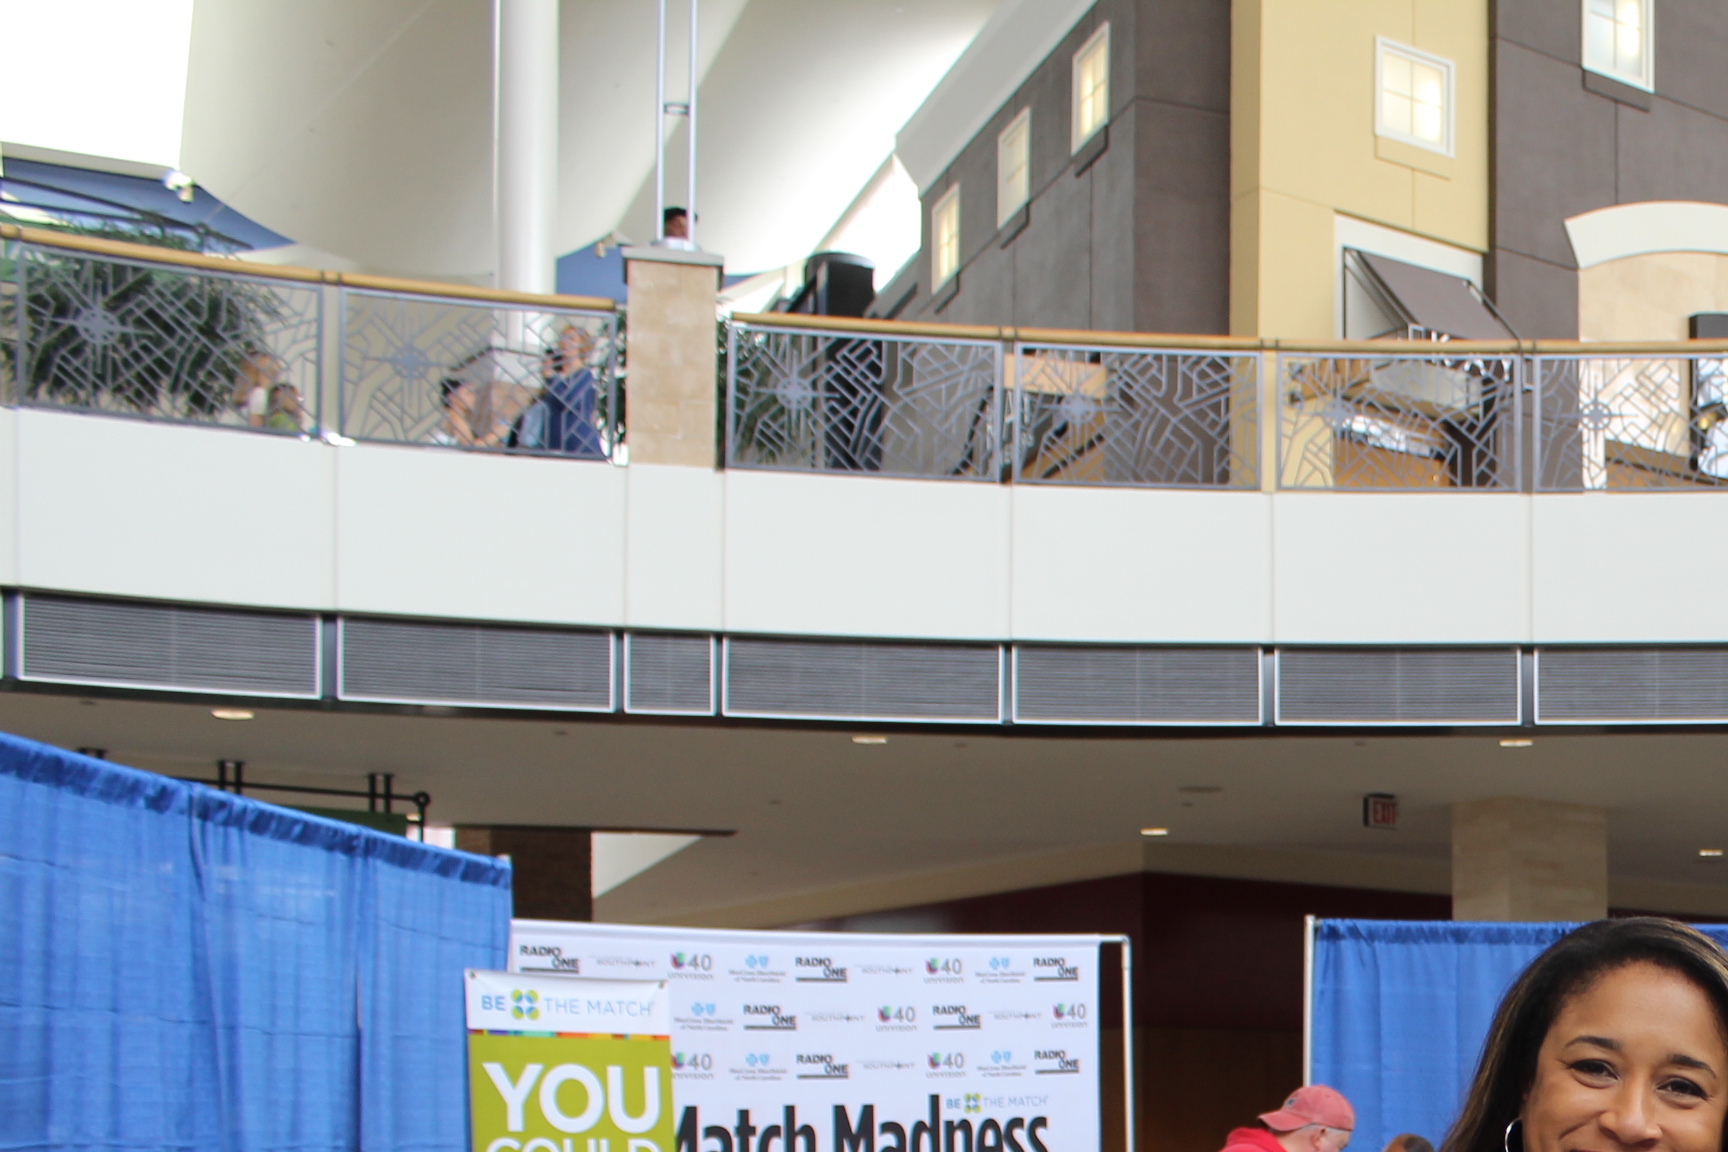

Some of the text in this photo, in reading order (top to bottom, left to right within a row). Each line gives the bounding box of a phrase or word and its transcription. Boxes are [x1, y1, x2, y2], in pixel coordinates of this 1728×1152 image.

[687, 954, 712, 971] 40
[940, 958, 963, 975] 40
[481, 995, 651, 1017] BE THE MATCH
[893, 1006, 916, 1023] 40
[1066, 1004, 1087, 1019] 40
[687, 1054, 712, 1070] 40
[942, 1052, 965, 1069] 40
[482, 1062, 661, 1134] YOU
[946, 1095, 1048, 1110] BE THE MATCH
